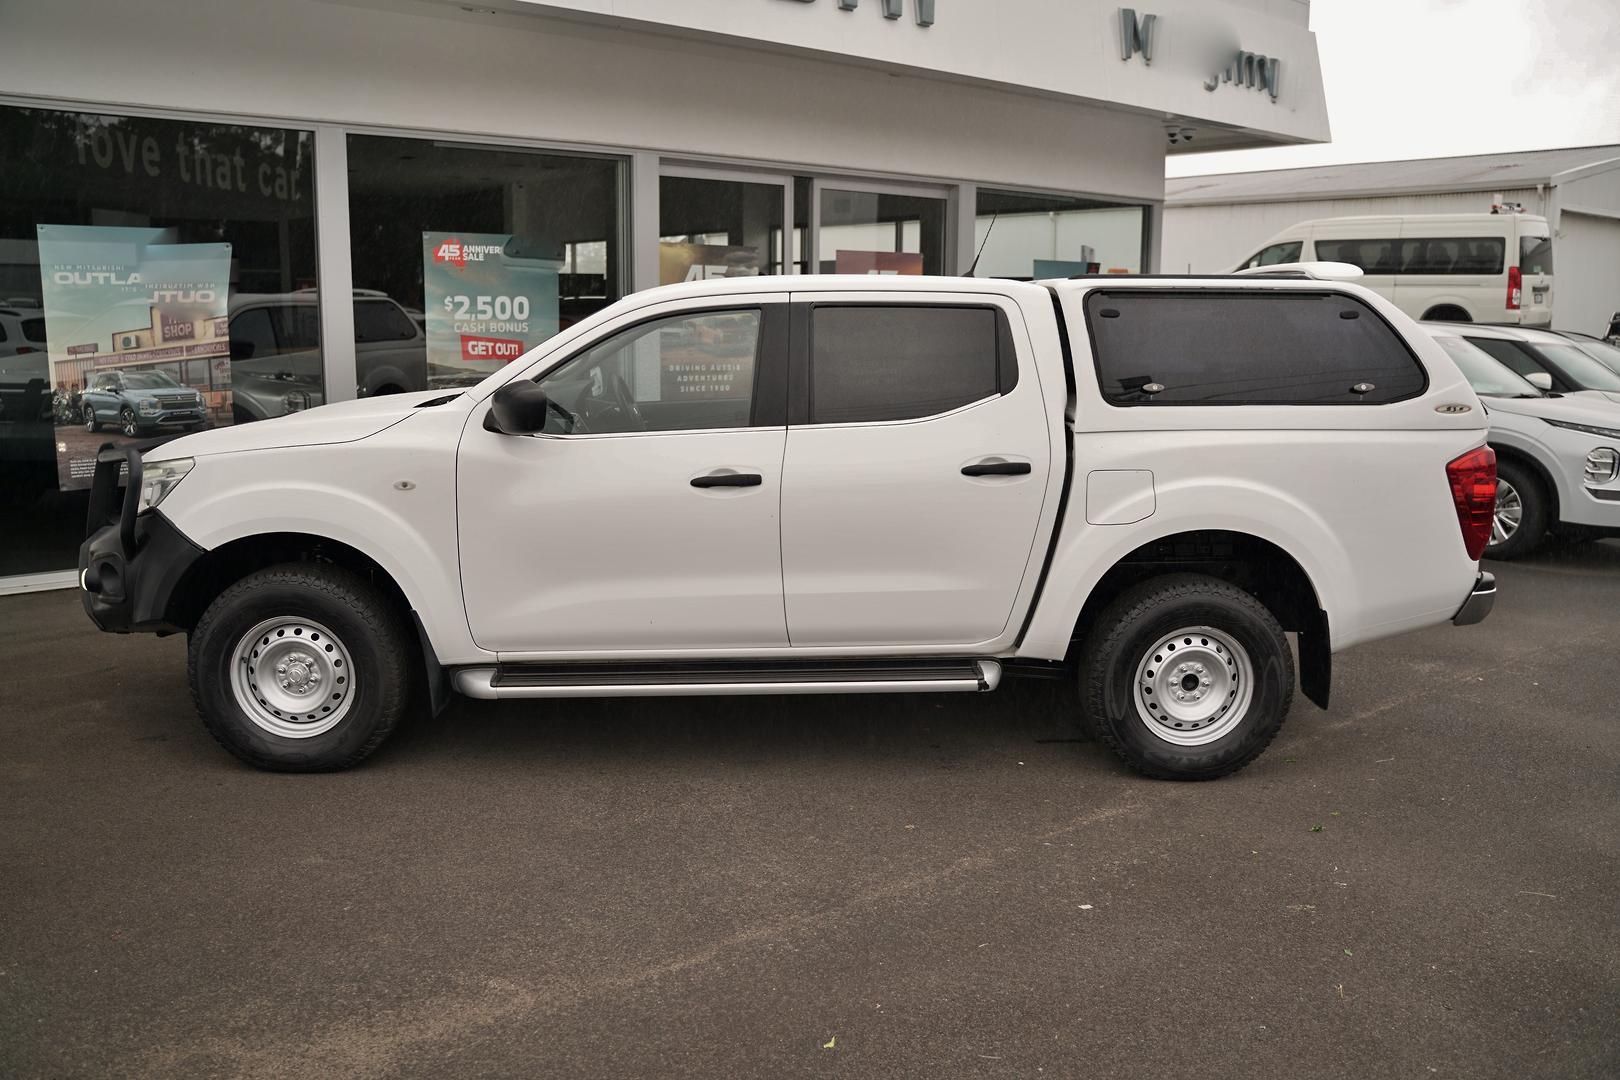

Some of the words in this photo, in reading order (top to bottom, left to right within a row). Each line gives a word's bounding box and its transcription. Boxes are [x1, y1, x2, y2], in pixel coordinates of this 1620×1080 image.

[176, 131, 246, 192] that
[257, 162, 301, 201] car
[437, 244, 460, 261] 45
[463, 253, 484, 261] SALE
[54, 271, 142, 285] OUTLA
[444, 295, 530, 321] $2,500
[164, 323, 192, 338] SHOP
[454, 321, 486, 333] CASH
[489, 321, 529, 333] BONUS
[468, 341, 495, 355] GET
[495, 343, 519, 355] OUT!
[669, 363, 706, 372] DRIVING
[710, 363, 741, 371] AUSSIE
[677, 373, 733, 382] ADVENTURES
[680, 384, 706, 393] SINCE
